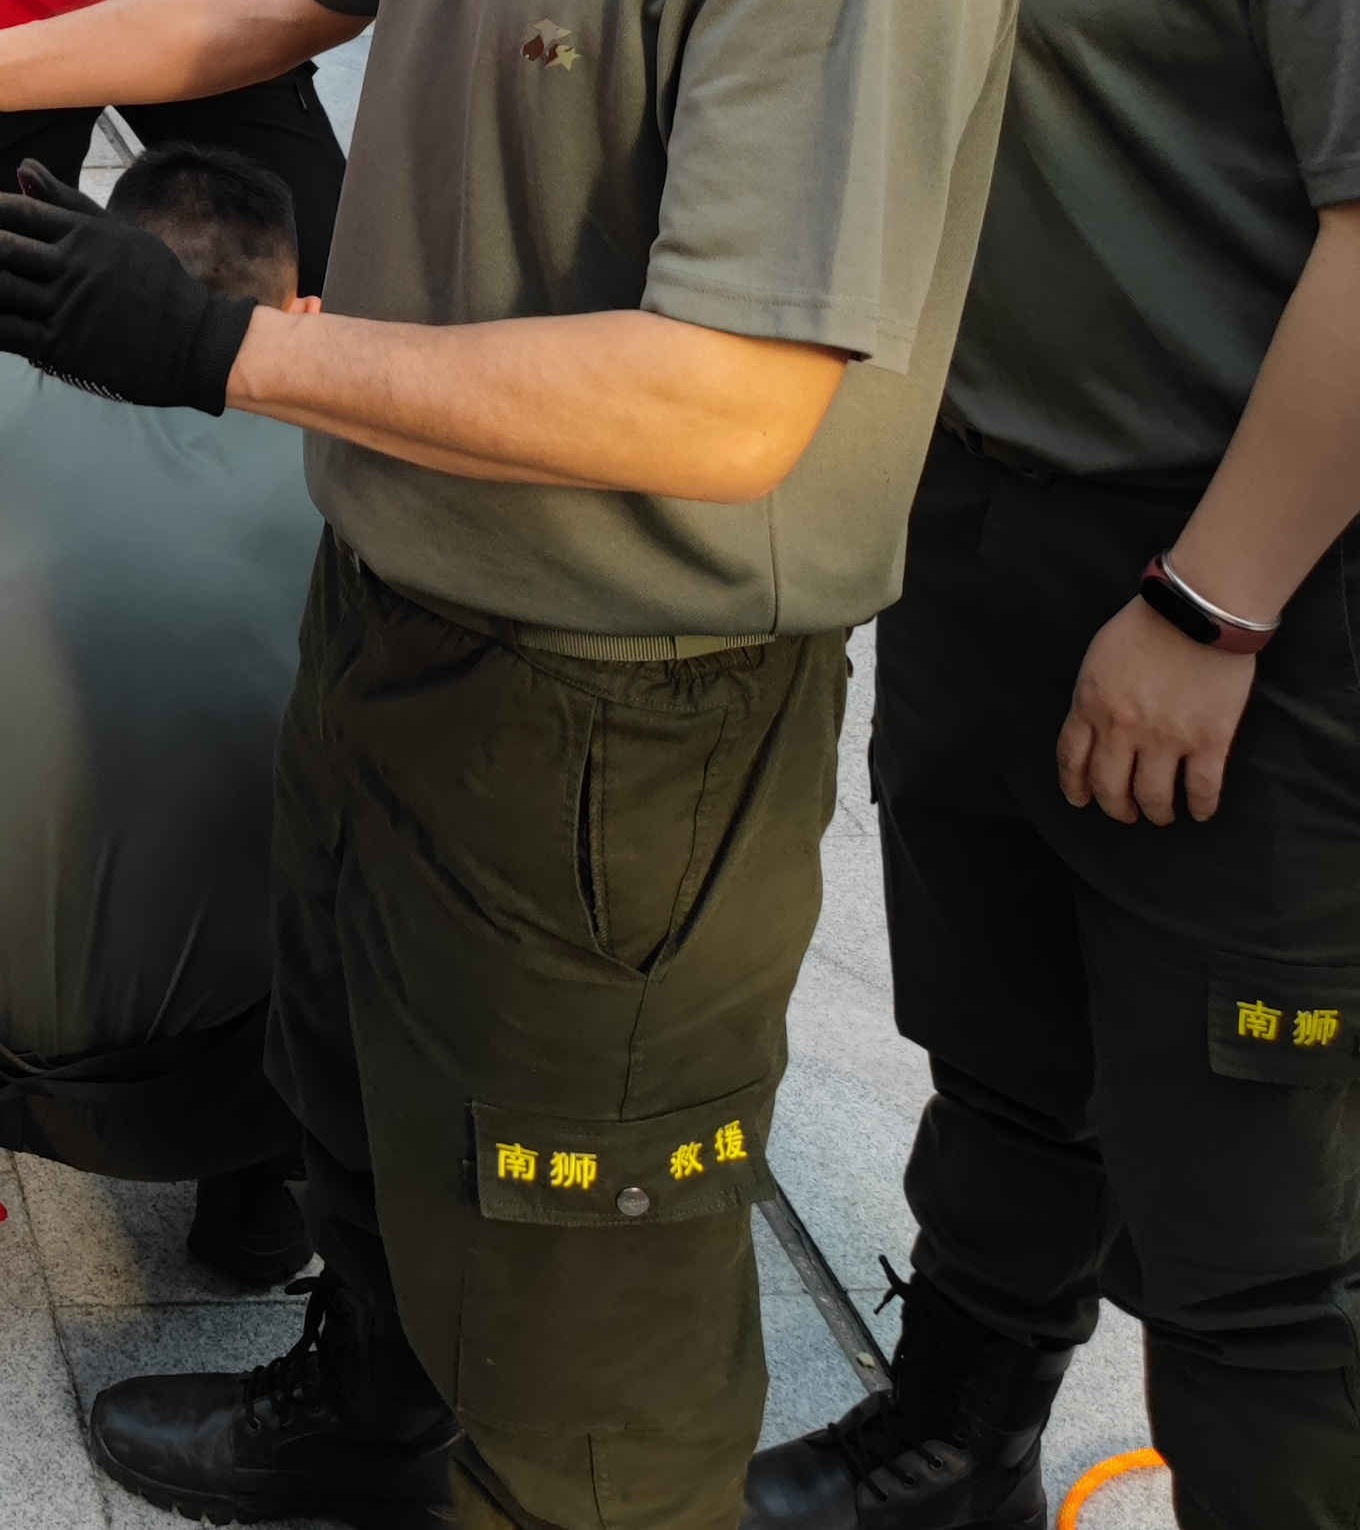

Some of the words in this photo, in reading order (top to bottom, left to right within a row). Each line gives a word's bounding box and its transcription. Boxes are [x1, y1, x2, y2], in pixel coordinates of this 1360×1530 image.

[1237, 1000, 1341, 1046] 南狮
[495, 1142, 598, 1190] 南狮
[670, 1119, 747, 1180] 救援
